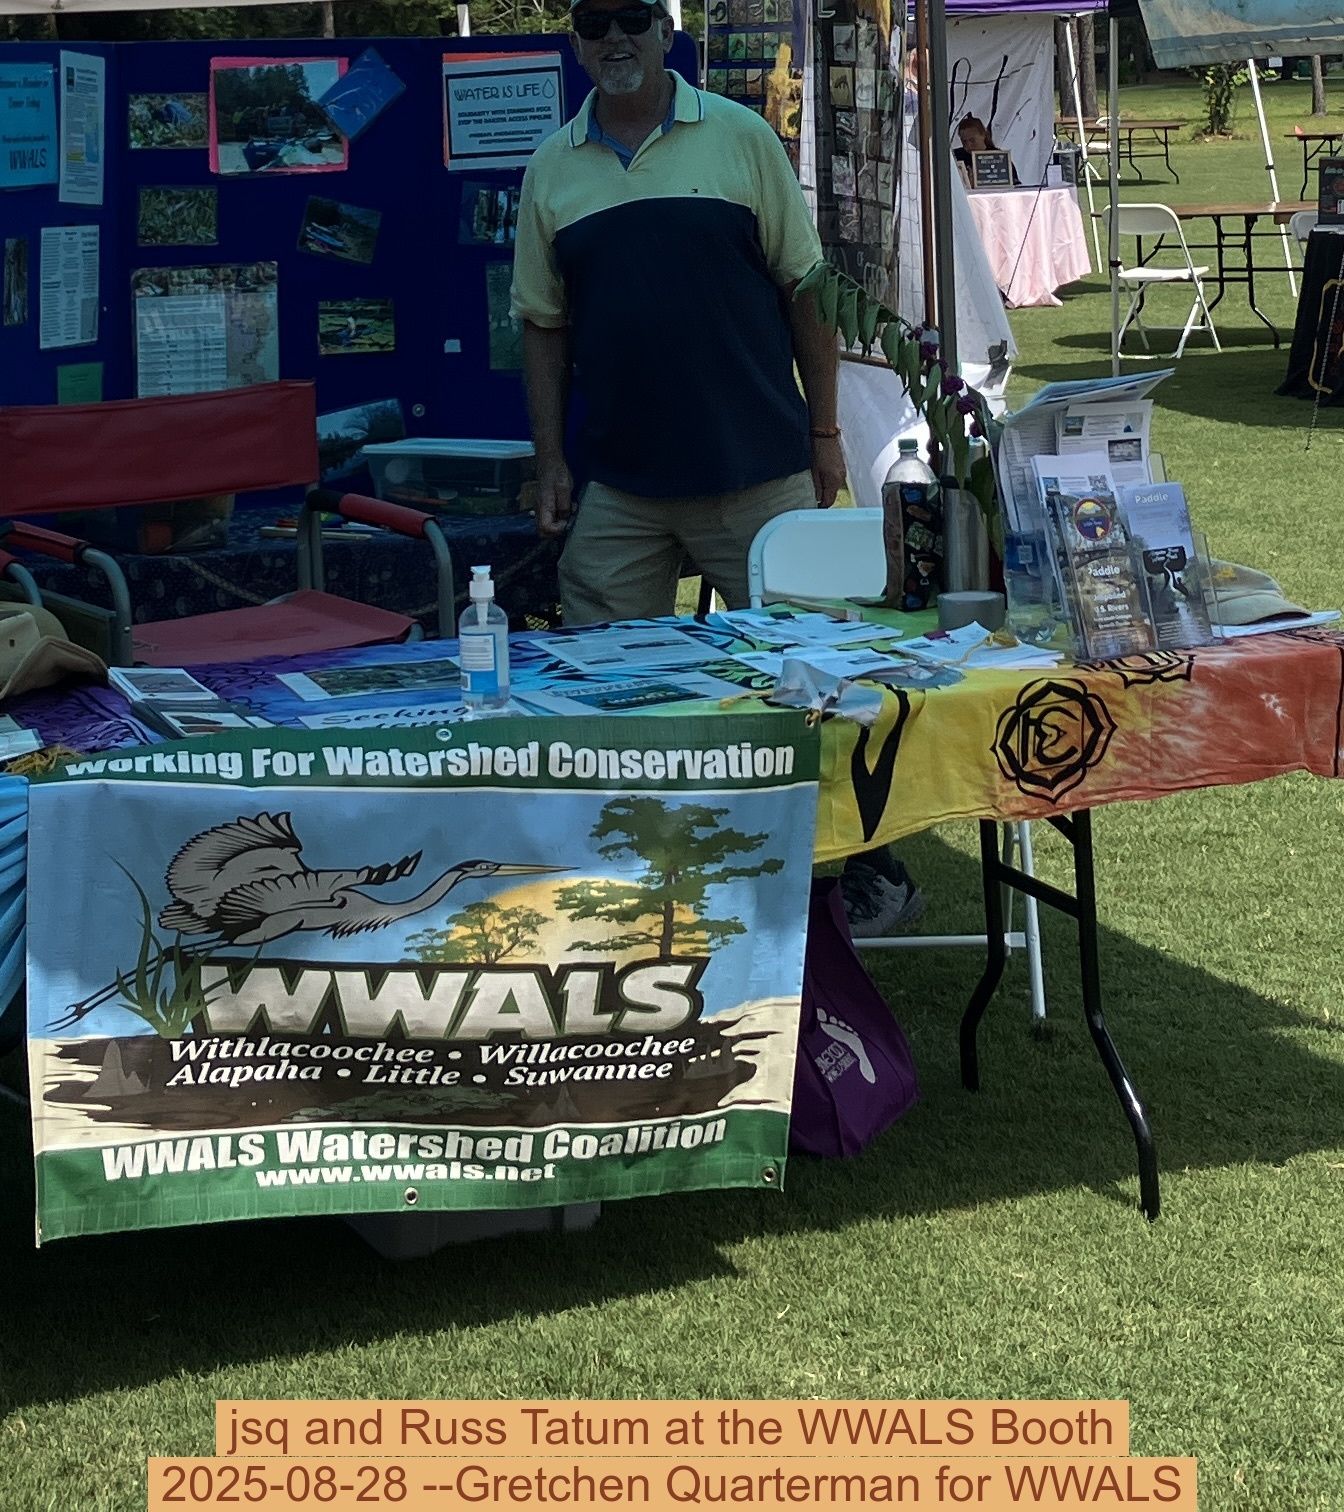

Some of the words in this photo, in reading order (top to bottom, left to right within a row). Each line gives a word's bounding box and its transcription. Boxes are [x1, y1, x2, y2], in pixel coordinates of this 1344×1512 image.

[454, 86, 500, 102] WATER
[502, 85, 513, 98] IS
[516, 83, 541, 98] LIFE
[9, 148, 47, 171] WWALS
[1135, 491, 1169, 504] Paddle
[66, 747, 244, 779] Working
[253, 747, 321, 778] For
[325, 742, 540, 778] Watershed
[547, 741, 795, 781] Conservation
[199, 964, 703, 1038] WWALS
[169, 1038, 435, 1065] Withlacoochee
[166, 1061, 321, 1089] Alapaha
[362, 1064, 460, 1086] Little
[503, 1060, 673, 1087] Suwannee
[102, 1132, 266, 1181] WWALS
[275, 1128, 534, 1163] Watershed
[542, 1116, 726, 1161] Coalition
[256, 1159, 557, 1188] www.wwals.net
